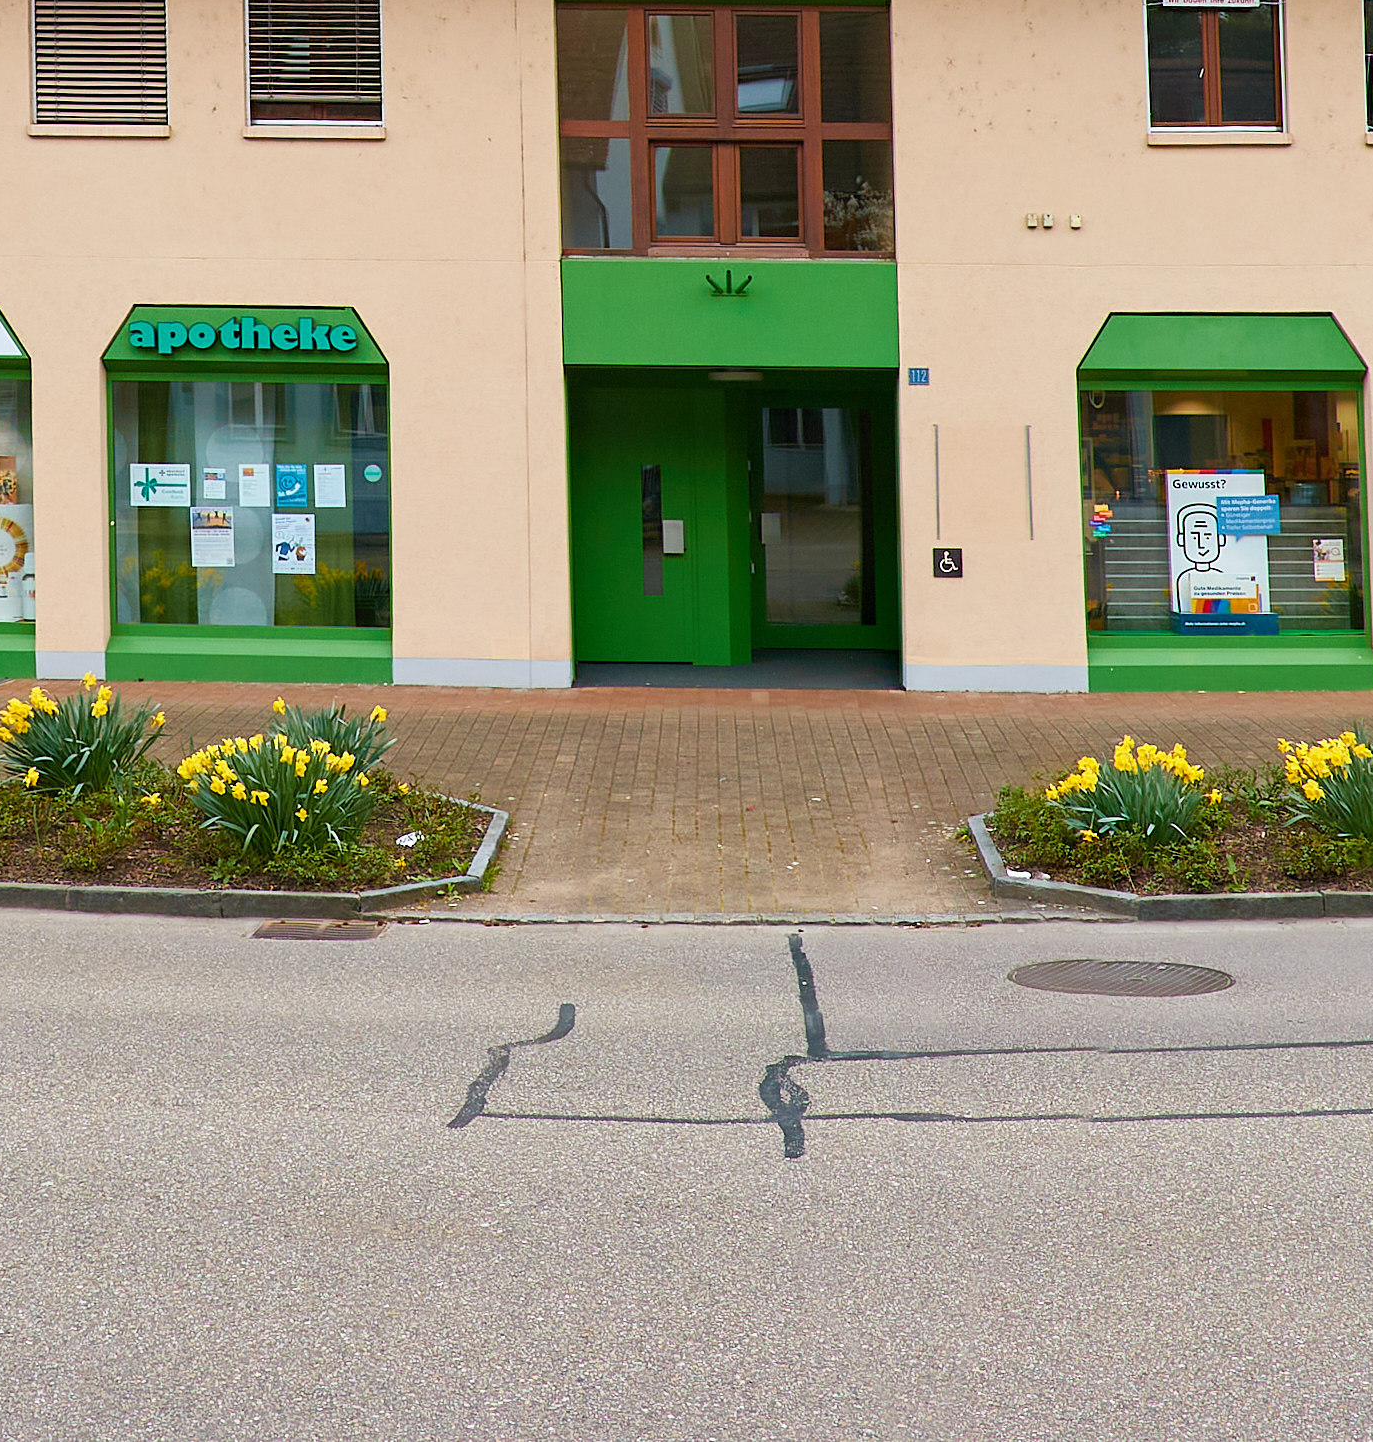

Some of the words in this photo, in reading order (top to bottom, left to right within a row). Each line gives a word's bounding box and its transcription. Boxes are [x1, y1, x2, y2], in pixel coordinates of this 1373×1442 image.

[129, 316, 358, 355] apotheke
[911, 370, 927, 383] 112
[1172, 479, 1227, 489] Gewusst?
[1231, 498, 1276, 506] Mepha-Generika
